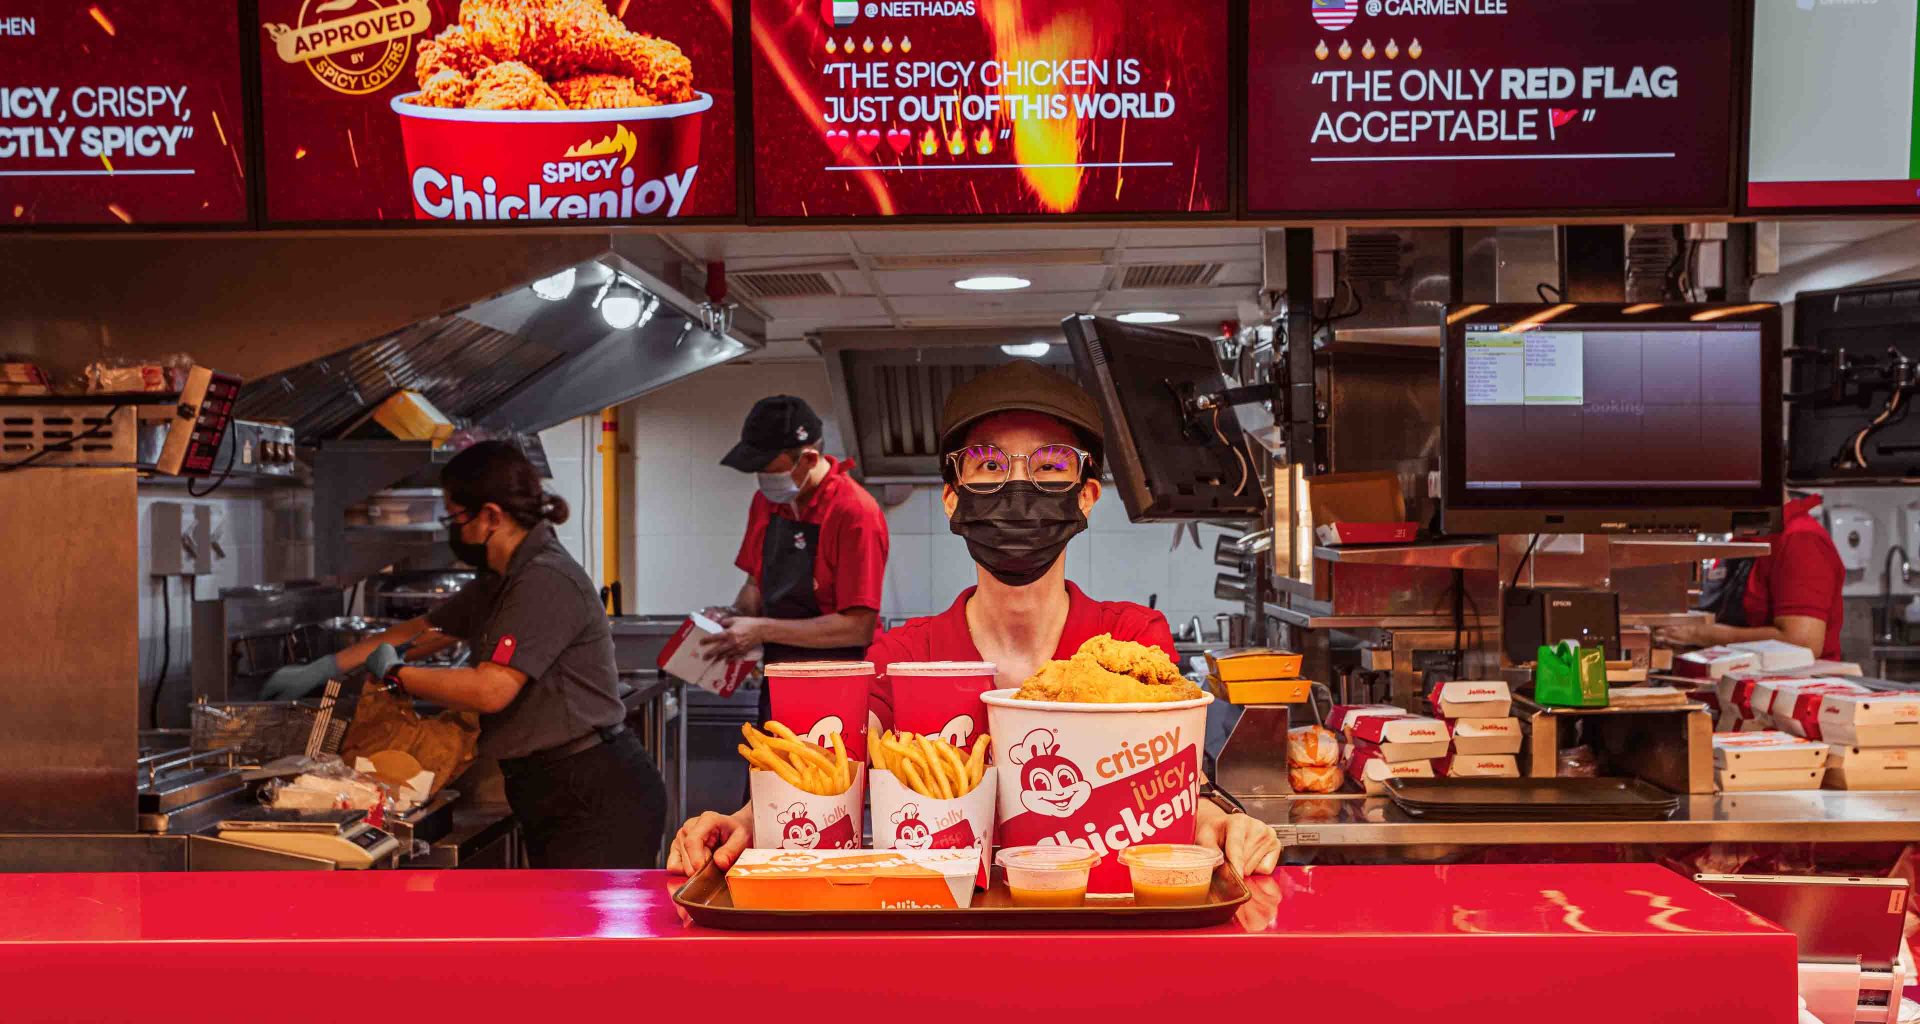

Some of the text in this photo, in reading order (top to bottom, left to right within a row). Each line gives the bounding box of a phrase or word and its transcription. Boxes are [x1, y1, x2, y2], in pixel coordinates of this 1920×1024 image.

[881, 1, 976, 17] NEETHADAS
[1385, 0, 1470, 16] CARMEN
[1474, 0, 1508, 15] LEE
[294, 10, 416, 55] APPROVED
[315, 41, 405, 90] SPICY LOVERS
[350, 52, 365, 65] BY
[894, 61, 976, 89] SPICY
[980, 58, 1108, 87] CHICKEN
[1117, 58, 1141, 85] IS
[1399, 69, 1494, 102] ONLY
[1500, 67, 1576, 100] RED
[1582, 66, 1678, 99] FLAG
[72, 86, 191, 122] CRISPY,
[823, 92, 1176, 123] JUST OUT OF THIS WORLD
[1311, 109, 1539, 144] ACCEPTABLE
[542, 157, 618, 184] SPICY
[1467, 688, 1496, 696] Jollibee
[1408, 728, 1436, 737] Jollibee
[1480, 724, 1508, 732] Jollibee
[1095, 726, 1181, 779] crispy
[1391, 765, 1420, 774] Jollibee
[1477, 761, 1505, 770] Jollibee
[1129, 761, 1186, 812] juicy
[822, 804, 847, 827] jolly
[934, 808, 964, 830] jolly
